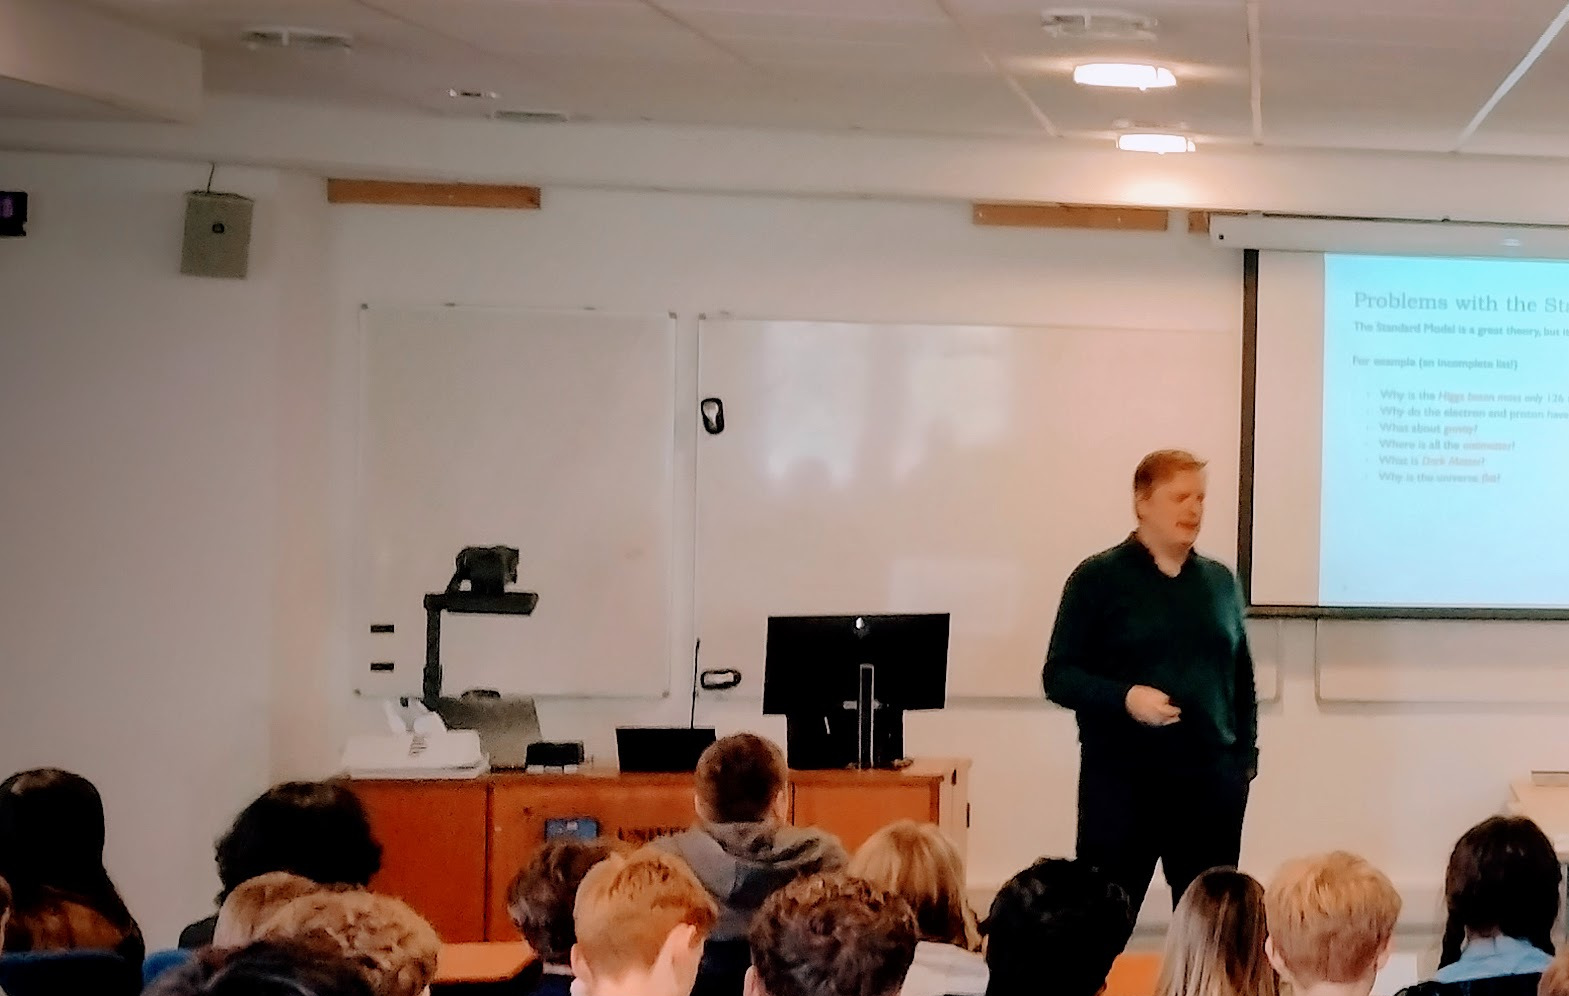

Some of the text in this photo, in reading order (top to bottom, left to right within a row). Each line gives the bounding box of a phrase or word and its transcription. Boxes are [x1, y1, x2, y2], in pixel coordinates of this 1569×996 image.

[1354, 291, 1448, 310] Problems
[1456, 294, 1498, 311] with
[1507, 295, 1537, 312] the
[1354, 321, 1373, 332] The
[1376, 322, 1421, 333] Standard
[1423, 323, 1455, 334] Model
[1458, 325, 1467, 334] is
[1477, 326, 1503, 337] great
[1506, 326, 1541, 338] theory,
[1544, 327, 1560, 337] but
[1562, 328, 1569, 337] it
[1353, 355, 1369, 366] For
[1373, 356, 1416, 368] example
[1419, 357, 1435, 370] (an
[1437, 358, 1493, 371] incomplete
[1380, 389, 1405, 402] Why
[1408, 391, 1416, 400] is
[1418, 390, 1436, 401] the
[1438, 391, 1465, 403] Higgs
[1467, 392, 1495, 402] boson
[1524, 393, 1543, 404] only
[1380, 406, 1405, 418] Why
[1407, 407, 1421, 417] do
[1424, 407, 1440, 417] the
[1443, 408, 1486, 418] electron
[1488, 408, 1507, 418] and
[1509, 409, 1544, 420] proton
[1547, 410, 1569, 420] have
[1379, 422, 1408, 433] What
[1411, 423, 1440, 433] about
[1379, 439, 1416, 450] Where
[1418, 440, 1426, 450] is
[1428, 439, 1440, 450] all
[1443, 440, 1460, 450] the
[1379, 455, 1408, 466] What
[1411, 456, 1418, 466] is
[1422, 456, 1445, 466] Dark
[1378, 471, 1403, 484] Why
[1406, 473, 1414, 483] is
[1416, 473, 1434, 483] the
